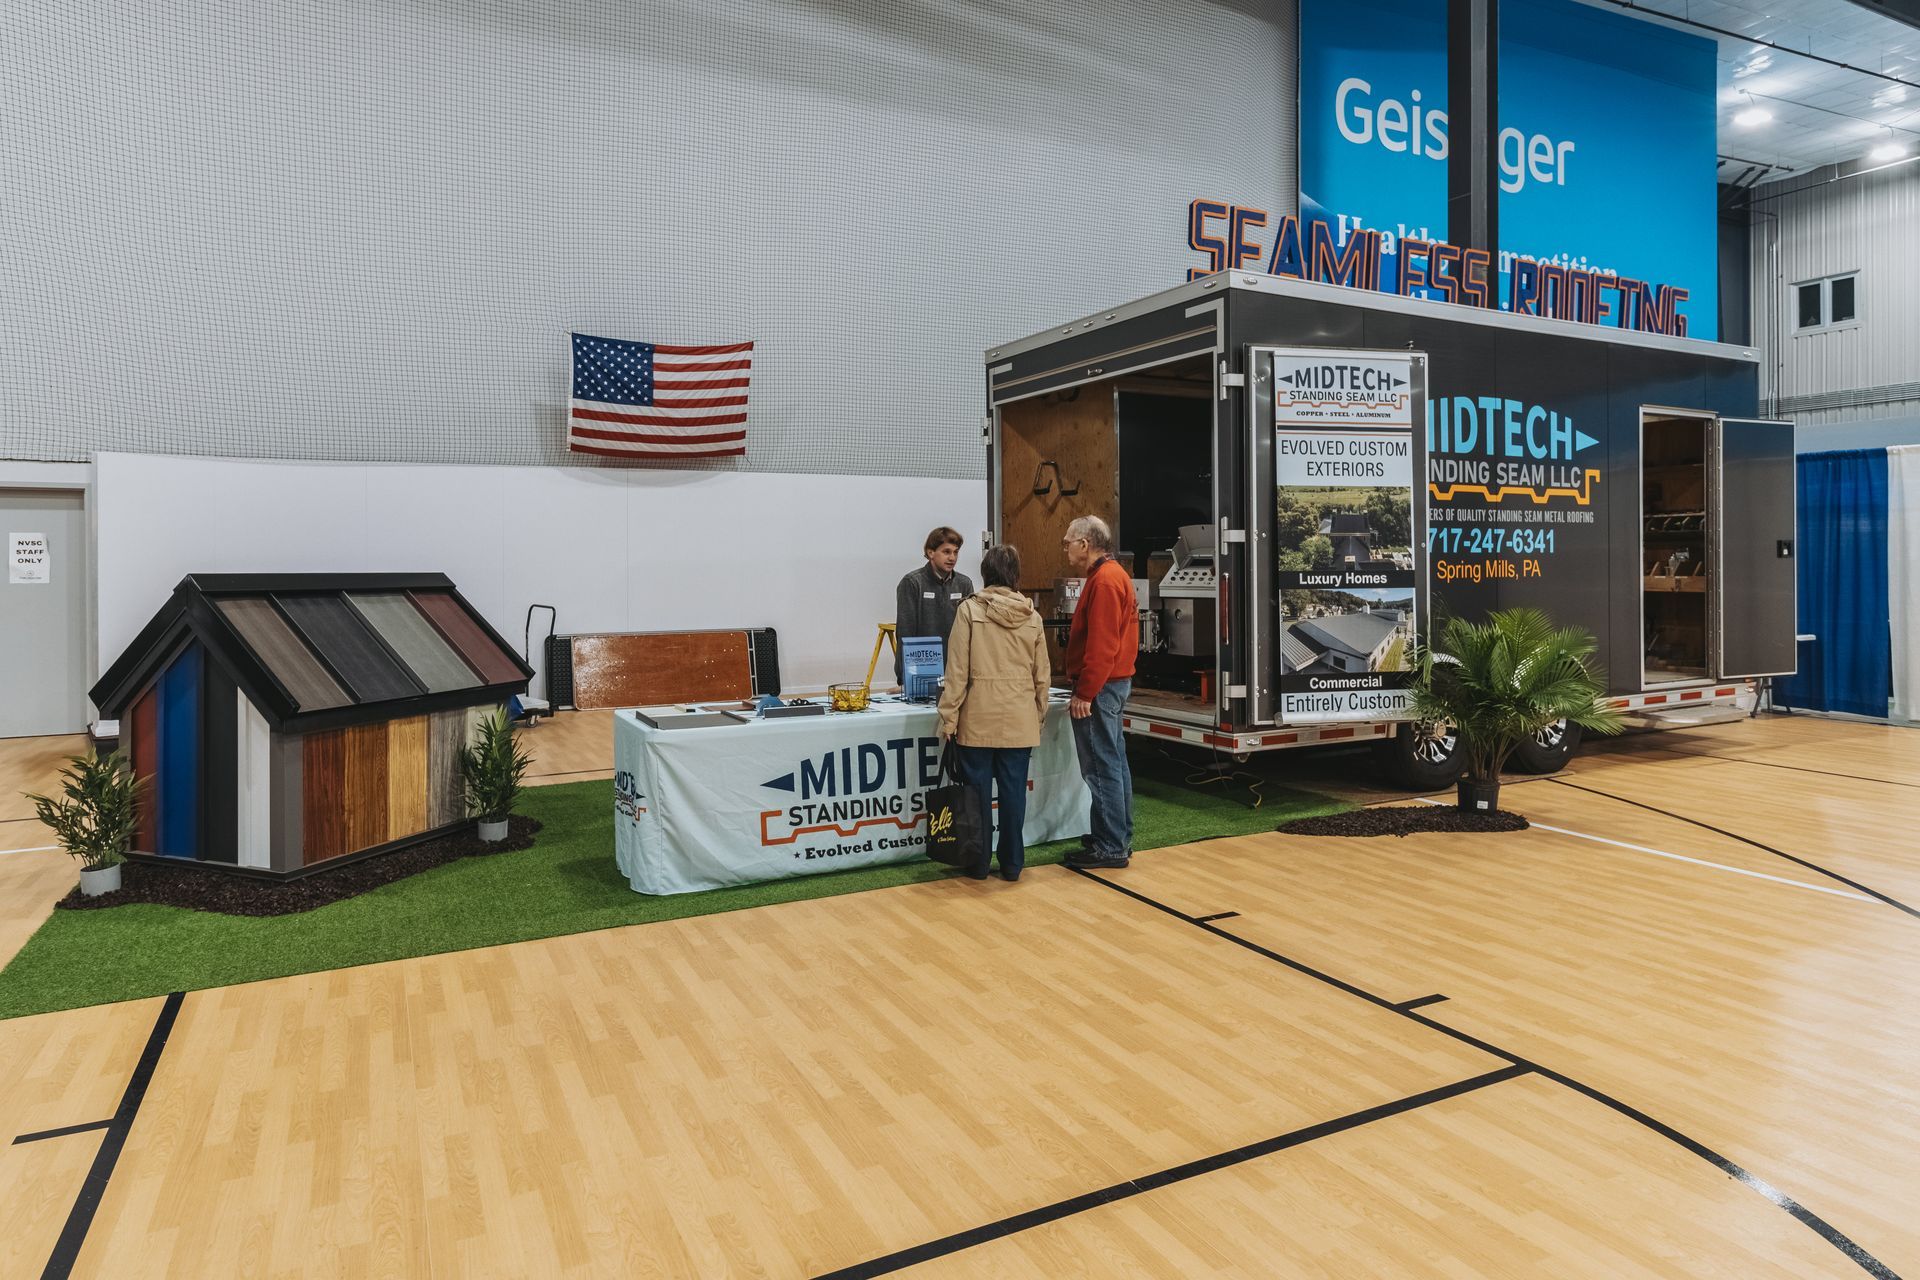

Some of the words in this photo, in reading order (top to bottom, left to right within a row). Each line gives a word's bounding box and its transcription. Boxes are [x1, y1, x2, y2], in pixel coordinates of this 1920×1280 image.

[1335, 77, 1575, 193] Geisger
[1295, 365, 1391, 391] MIDTECH
[1289, 390, 1343, 401] STANDING
[1346, 392, 1375, 402] SEAM
[1378, 393, 1397, 403] LLC
[1428, 396, 1572, 460] IDTECH
[1281, 439, 1344, 456] EVOLVED
[1349, 441, 1407, 457] CUSTOM
[1307, 461, 1384, 477] EXTERIORS
[1430, 459, 1490, 484] NDING
[1496, 462, 1545, 486] SEAM
[1551, 465, 1581, 488] LLC
[1446, 509, 1455, 521] OF
[1457, 509, 1486, 522] QUALITY
[1488, 509, 1523, 523] STANDING
[1524, 510, 1543, 523] SEAM
[1544, 510, 1565, 523] METAL
[1567, 511, 1594, 523] ROOFING
[1429, 527, 1554, 554] 717-247-6341
[1299, 573, 1342, 587] Luxury
[1345, 572, 1388, 584] Homes
[1437, 560, 1481, 583] Spring
[1485, 559, 1519, 580] Mills,
[1523, 559, 1541, 577] PA
[1309, 675, 1383, 689] Commercial
[1286, 693, 1343, 712] Entirely
[1348, 693, 1406, 710] Custom
[801, 737, 940, 800] MIDTE
[789, 795, 903, 827] STANDING
[805, 840, 873, 860] Evolved
